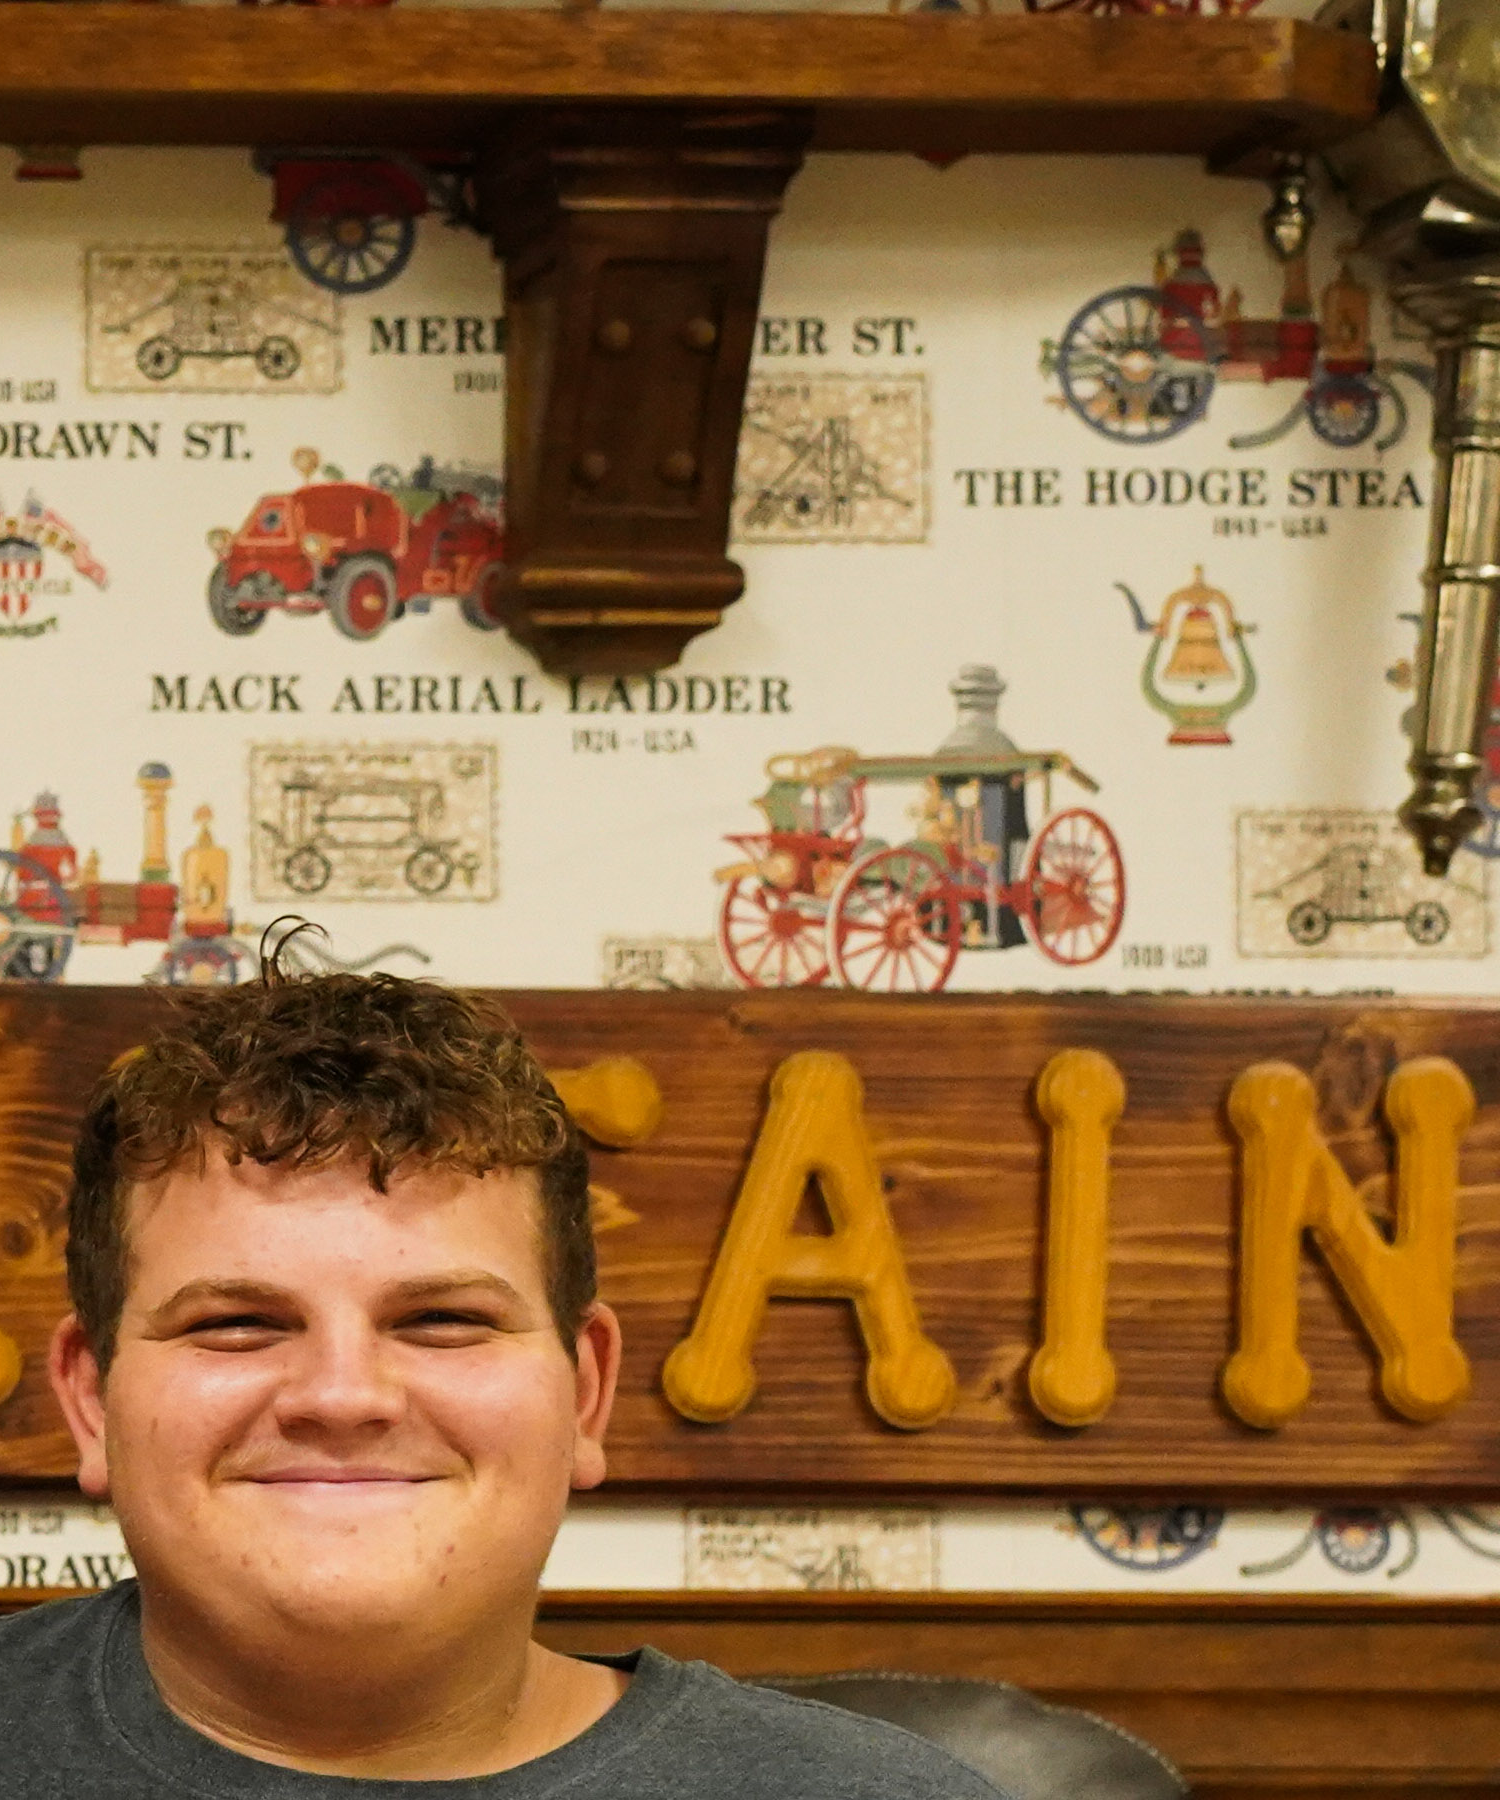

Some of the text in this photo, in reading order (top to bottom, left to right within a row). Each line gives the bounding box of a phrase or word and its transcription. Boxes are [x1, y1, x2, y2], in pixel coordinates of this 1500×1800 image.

[852, 317, 926, 357] ST.
[182, 422, 252, 462] ST.
[955, 469, 1426, 509] THE HODGE STEA
[150, 675, 794, 714] MACK AERIAL LADDER
